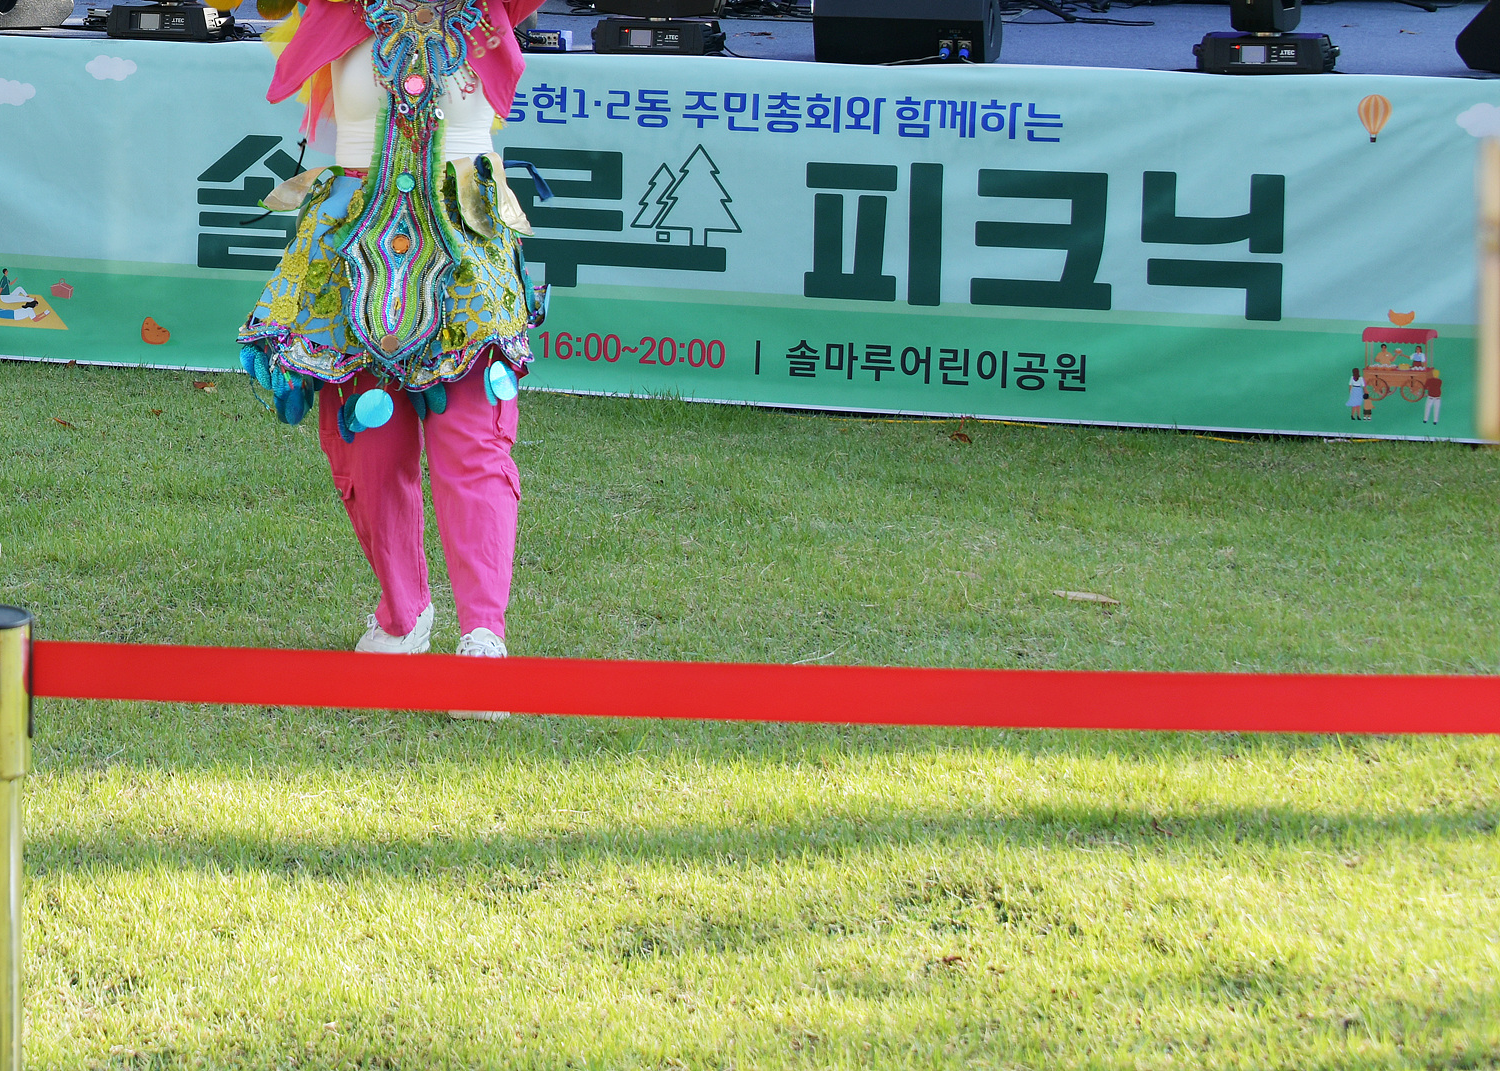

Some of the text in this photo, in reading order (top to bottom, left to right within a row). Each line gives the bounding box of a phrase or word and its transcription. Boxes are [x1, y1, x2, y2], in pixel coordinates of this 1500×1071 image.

[682, 90, 887, 135] 주민총회와
[895, 96, 1063, 142] 함께하는
[803, 162, 1286, 321] 피크닉
[538, 331, 1087, 392] 16:00~20:00 솔마루어린이공원
